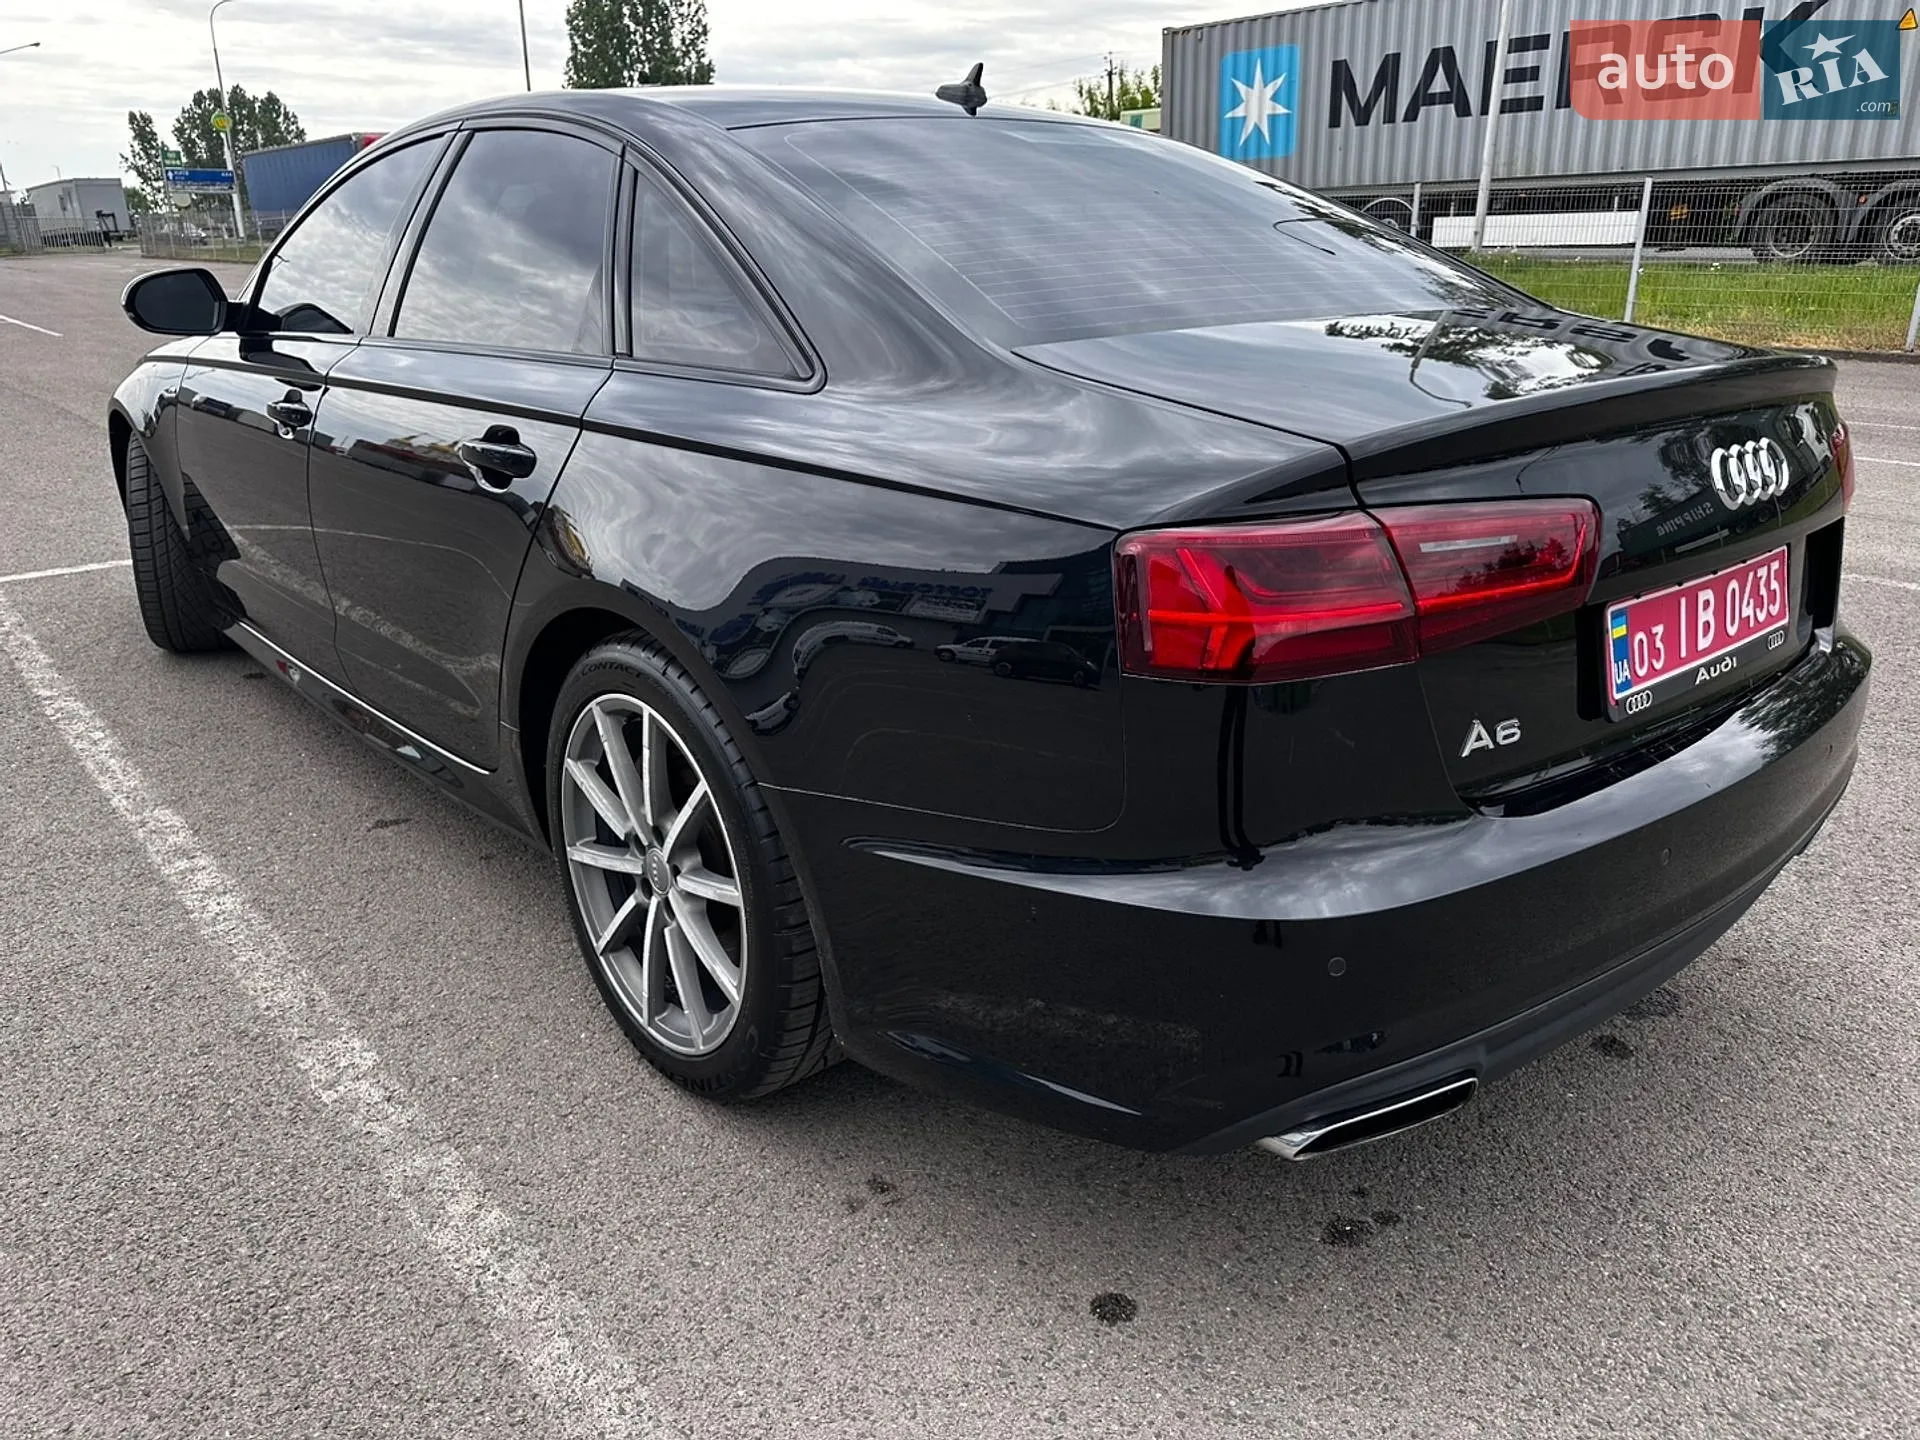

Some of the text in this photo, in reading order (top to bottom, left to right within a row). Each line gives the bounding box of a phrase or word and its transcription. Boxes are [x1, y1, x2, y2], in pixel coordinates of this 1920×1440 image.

[1328, 0, 1828, 128] MAERSK
[1633, 623, 1665, 678] 03
[1725, 560, 1781, 637] 0435
[1614, 659, 1631, 684] UA
[1695, 656, 1738, 685] Audi
[1459, 716, 1522, 758] A6
